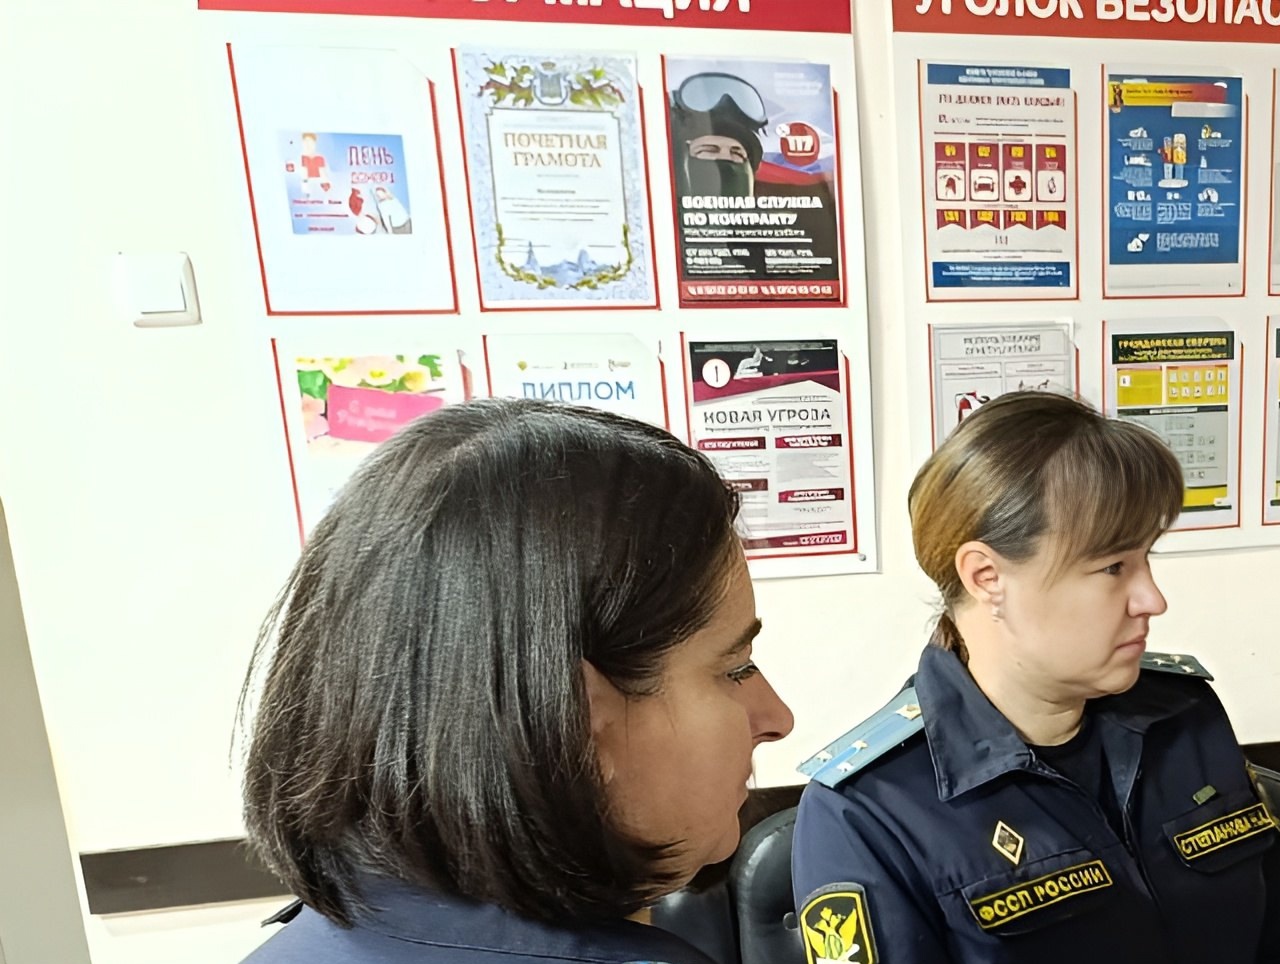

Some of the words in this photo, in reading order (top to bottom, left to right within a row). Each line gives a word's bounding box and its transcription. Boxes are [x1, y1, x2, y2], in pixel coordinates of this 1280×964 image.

[513, 151, 602, 168] ГРАМОТА
[522, 381, 635, 401] ДИПЛОМ
[978, 889, 1034, 922] ФССП
[1033, 867, 1105, 902] РОССИИ
